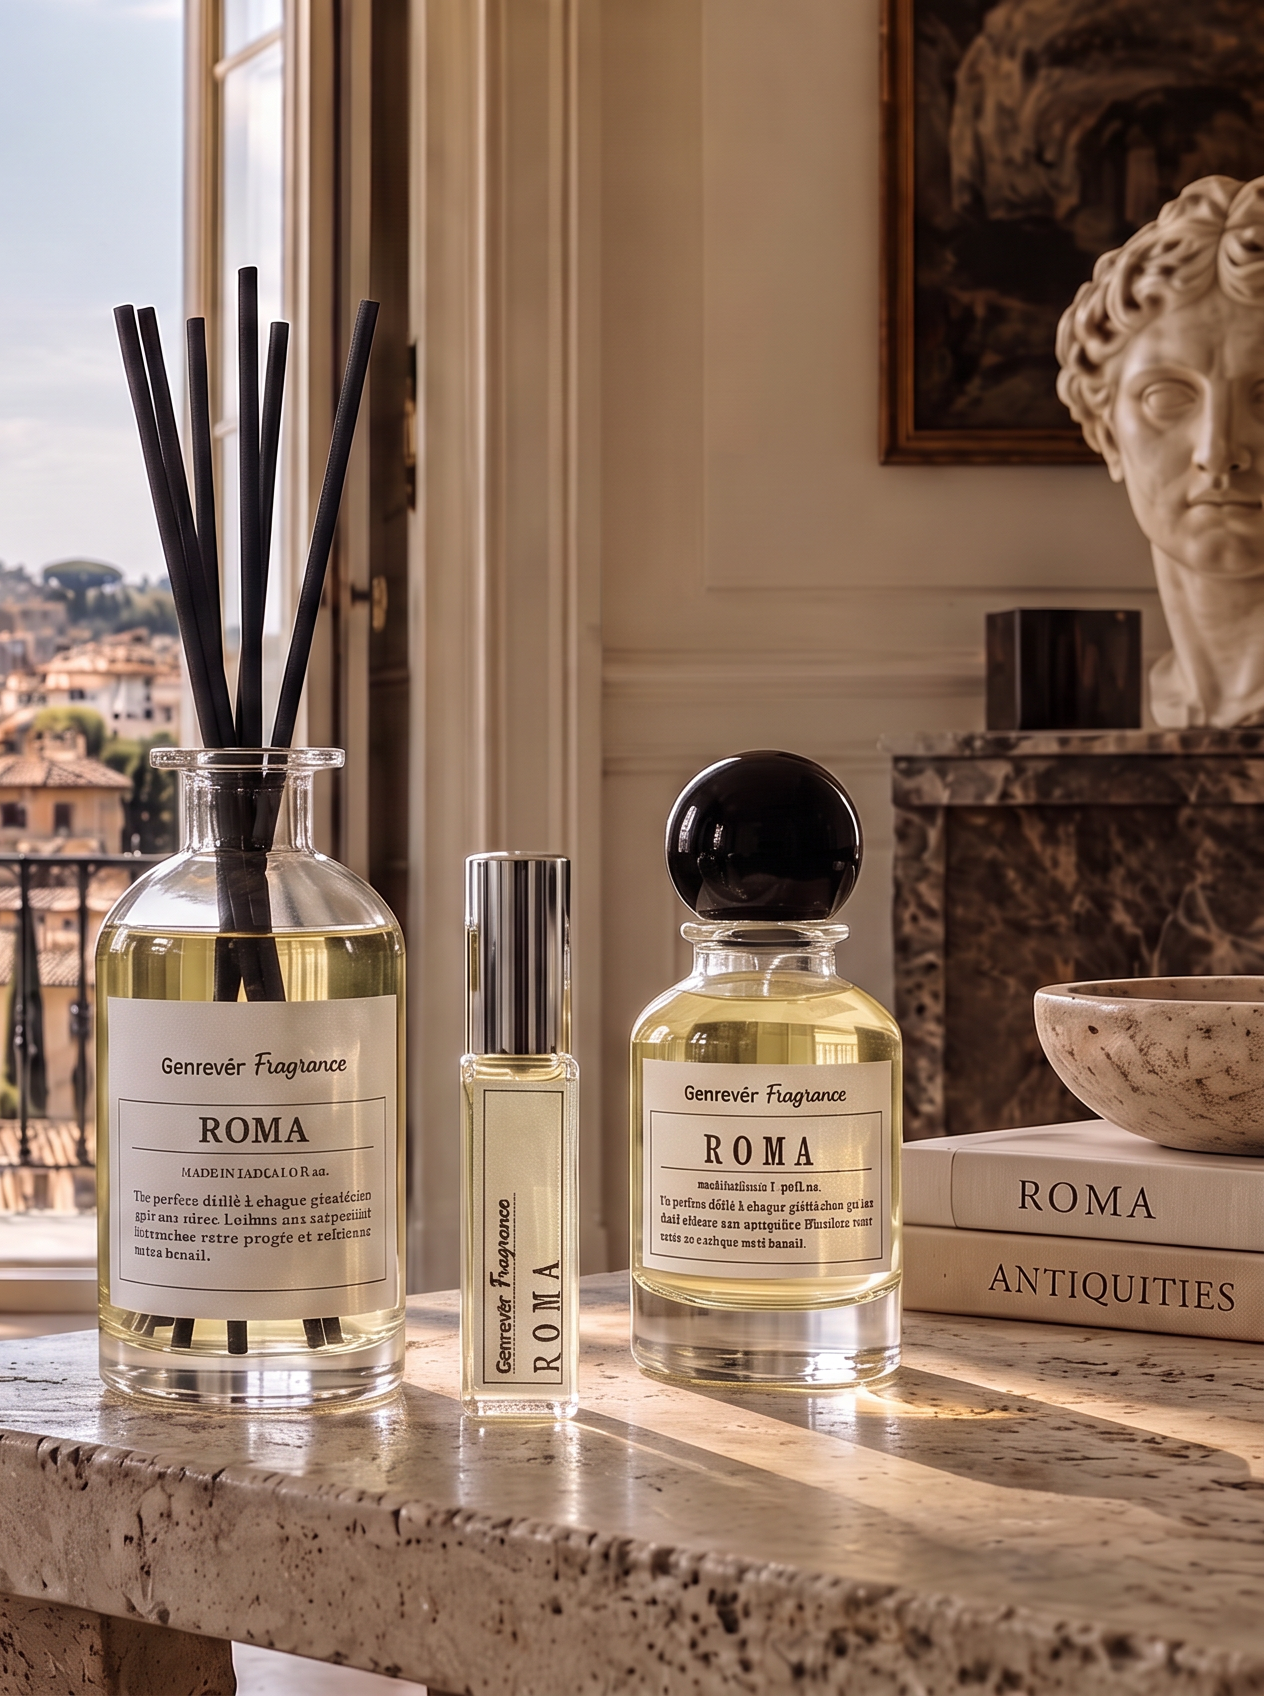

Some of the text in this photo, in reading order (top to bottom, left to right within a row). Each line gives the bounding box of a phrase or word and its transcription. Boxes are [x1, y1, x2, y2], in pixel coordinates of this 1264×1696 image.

[161, 1051, 347, 1080] Genrevér Fragrance
[684, 1083, 847, 1108] Genrevér Fragrance
[198, 1116, 310, 1144] ROMA
[703, 1133, 814, 1166] ROMA
[1018, 1180, 1156, 1220] ROMA
[298, 1231, 312, 1243] et
[988, 1263, 1235, 1312] ANTIQUITIES
[532, 1260, 561, 1373] ROMA
